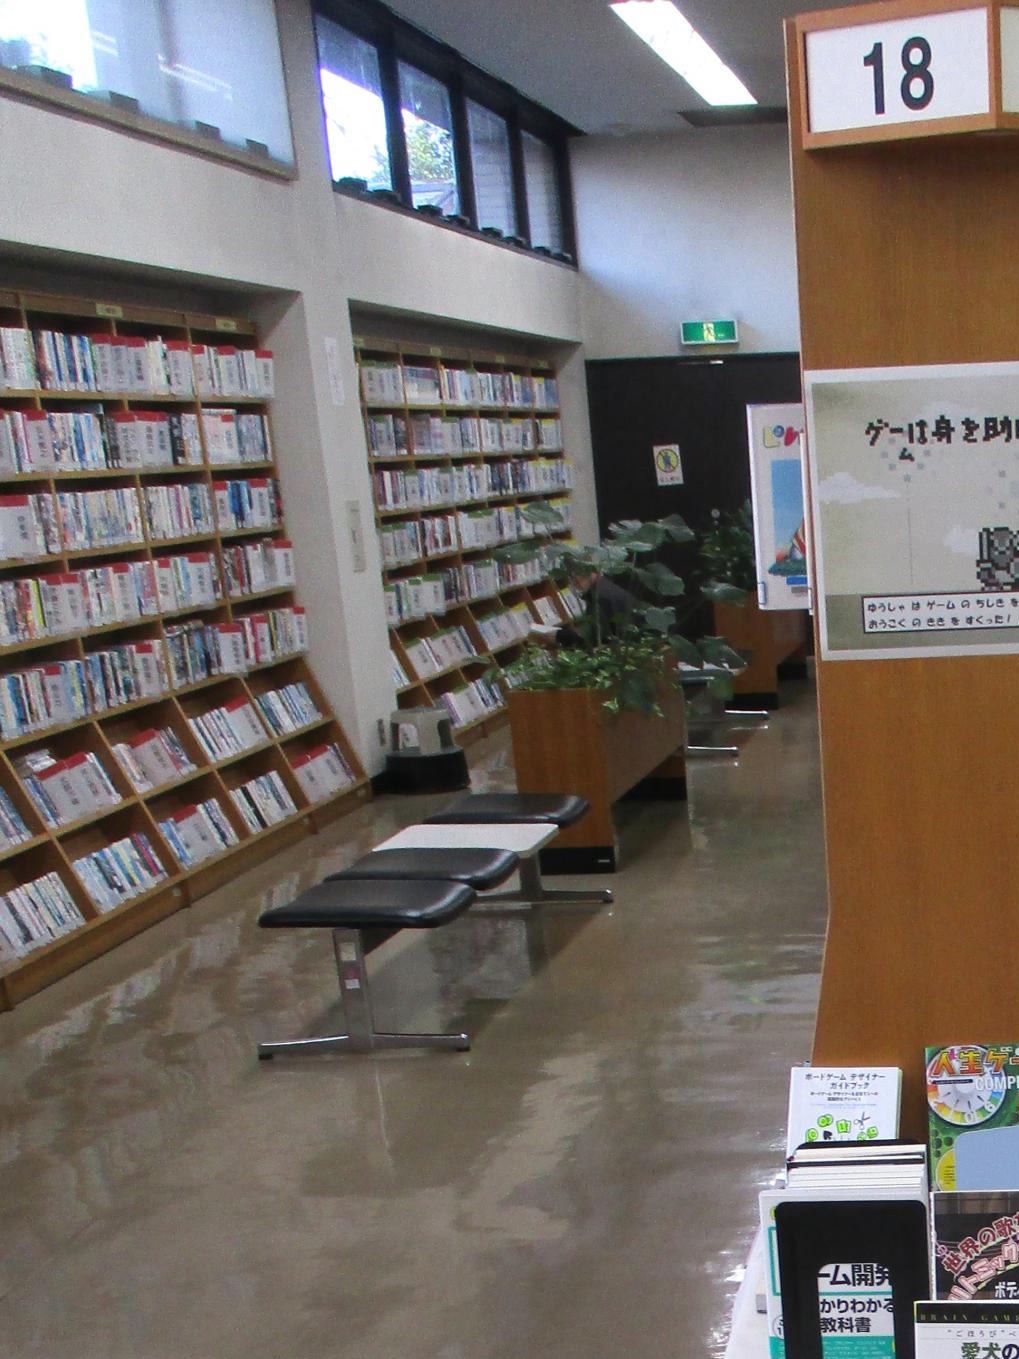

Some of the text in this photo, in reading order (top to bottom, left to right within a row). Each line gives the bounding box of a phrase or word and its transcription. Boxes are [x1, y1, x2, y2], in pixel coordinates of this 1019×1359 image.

[864, 36, 934, 115] 18
[868, 602, 905, 612] ゆうしゃ
[911, 602, 920, 610] は
[927, 600, 955, 610] ゲーム
[961, 600, 970, 608] の
[976, 599, 1002, 608] ちしき
[868, 619, 906, 629] おうこく
[912, 619, 920, 627] の
[820, 1317, 871, 1333] 教科書
